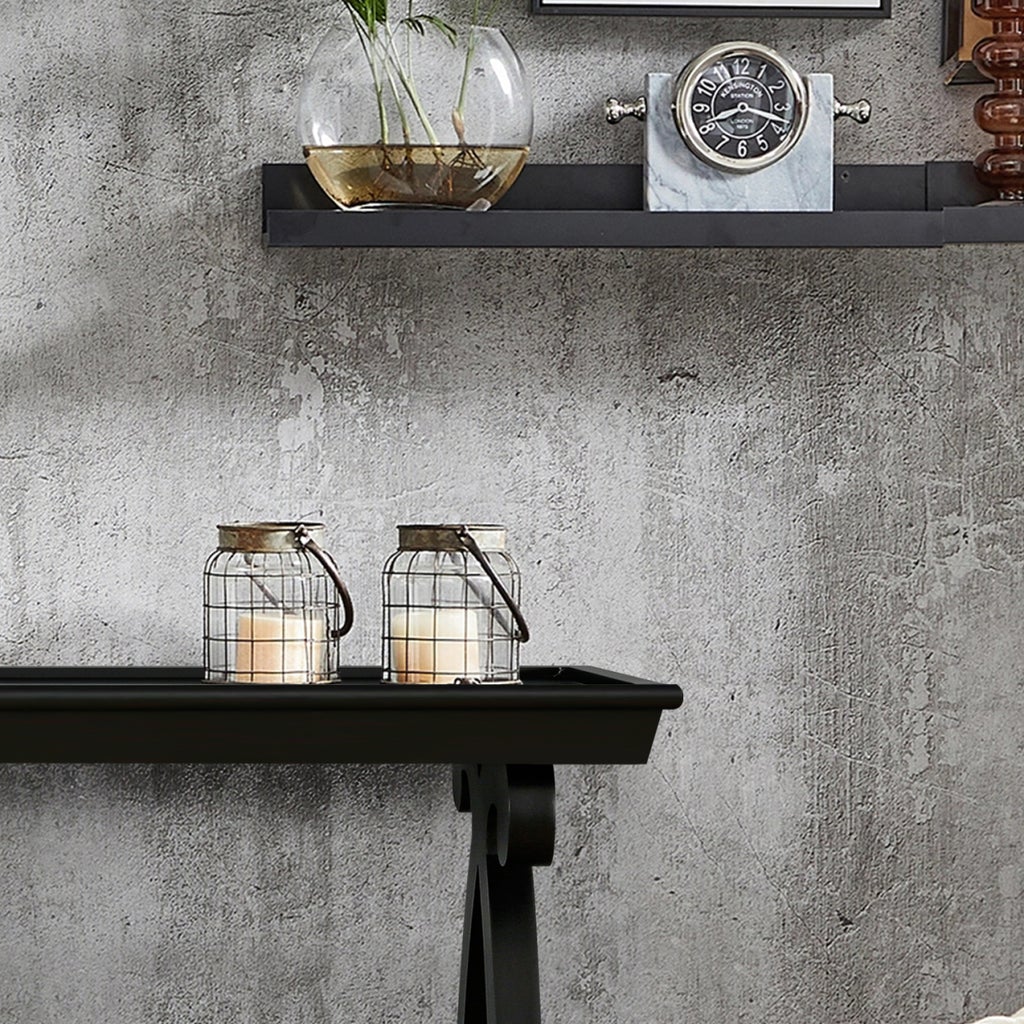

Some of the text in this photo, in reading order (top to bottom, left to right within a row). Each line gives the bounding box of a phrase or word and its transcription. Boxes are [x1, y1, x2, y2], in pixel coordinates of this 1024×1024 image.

[713, 61, 731, 82] 11
[733, 58, 750, 75] 12
[757, 64, 767, 79] 1
[697, 78, 717, 97] 10
[720, 81, 764, 98] KENSINGTON
[768, 80, 786, 94] 2
[692, 103, 710, 113] 9
[774, 102, 792, 111] 3
[699, 122, 716, 135] 8
[770, 122, 786, 135] 4
[715, 135, 730, 150] 7
[737, 140, 747, 157] 6
[756, 134, 769, 151] 5
